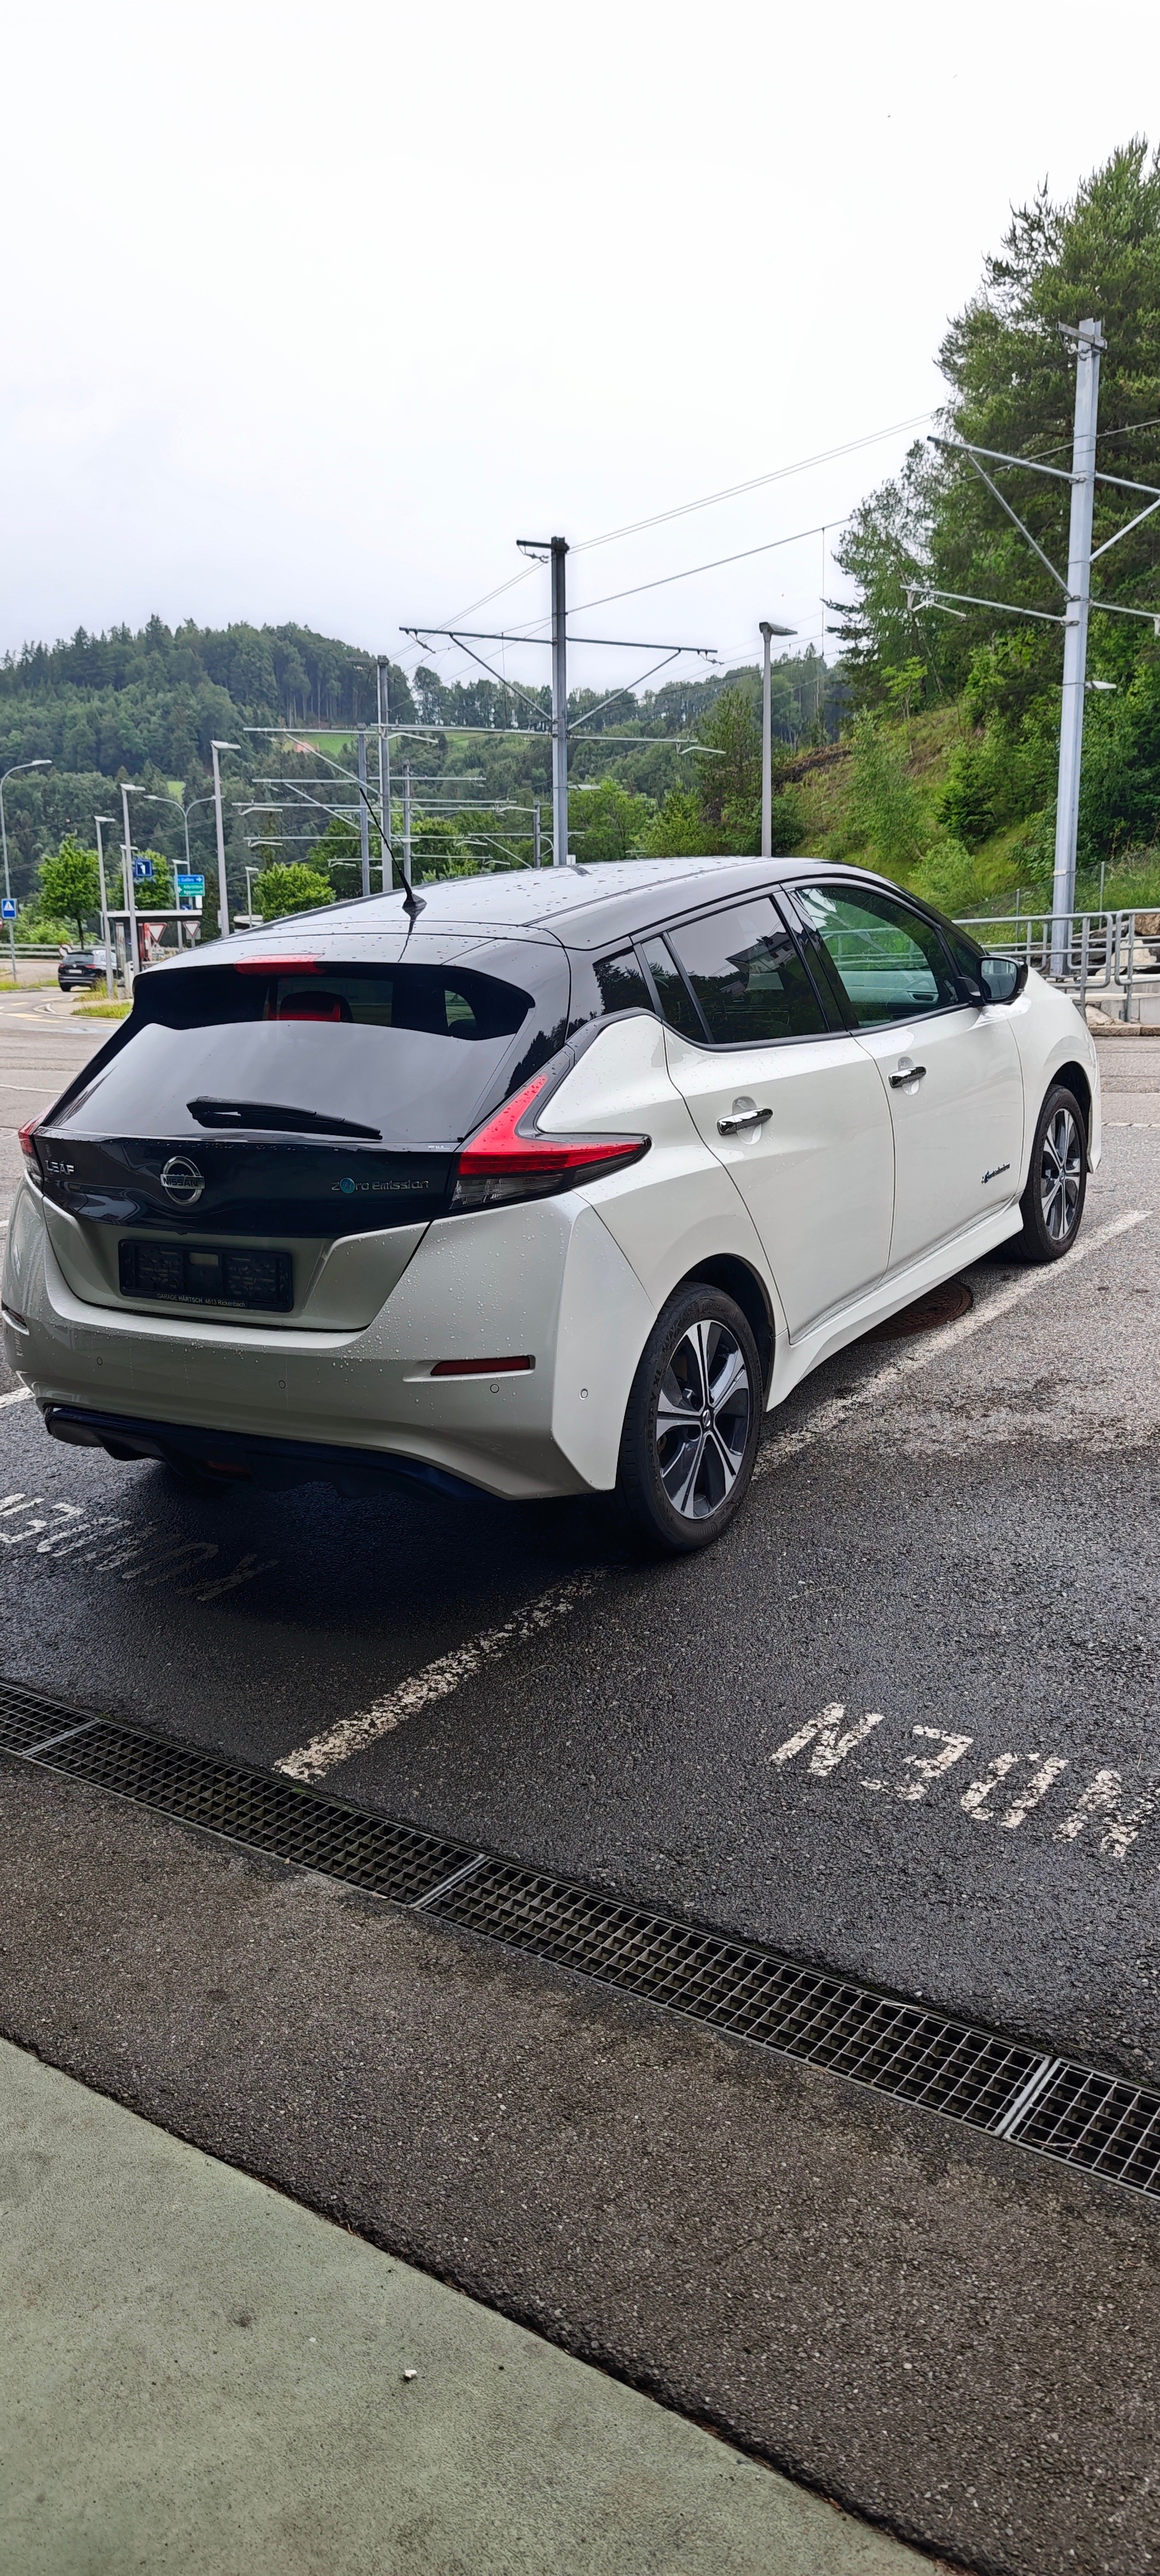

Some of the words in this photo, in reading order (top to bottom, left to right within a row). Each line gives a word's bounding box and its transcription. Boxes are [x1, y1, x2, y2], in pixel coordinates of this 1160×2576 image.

[45, 1160, 74, 1175] LEAF
[163, 1177, 199, 1187] NISSAN
[218, 1299, 245, 1307] Rickenbach
